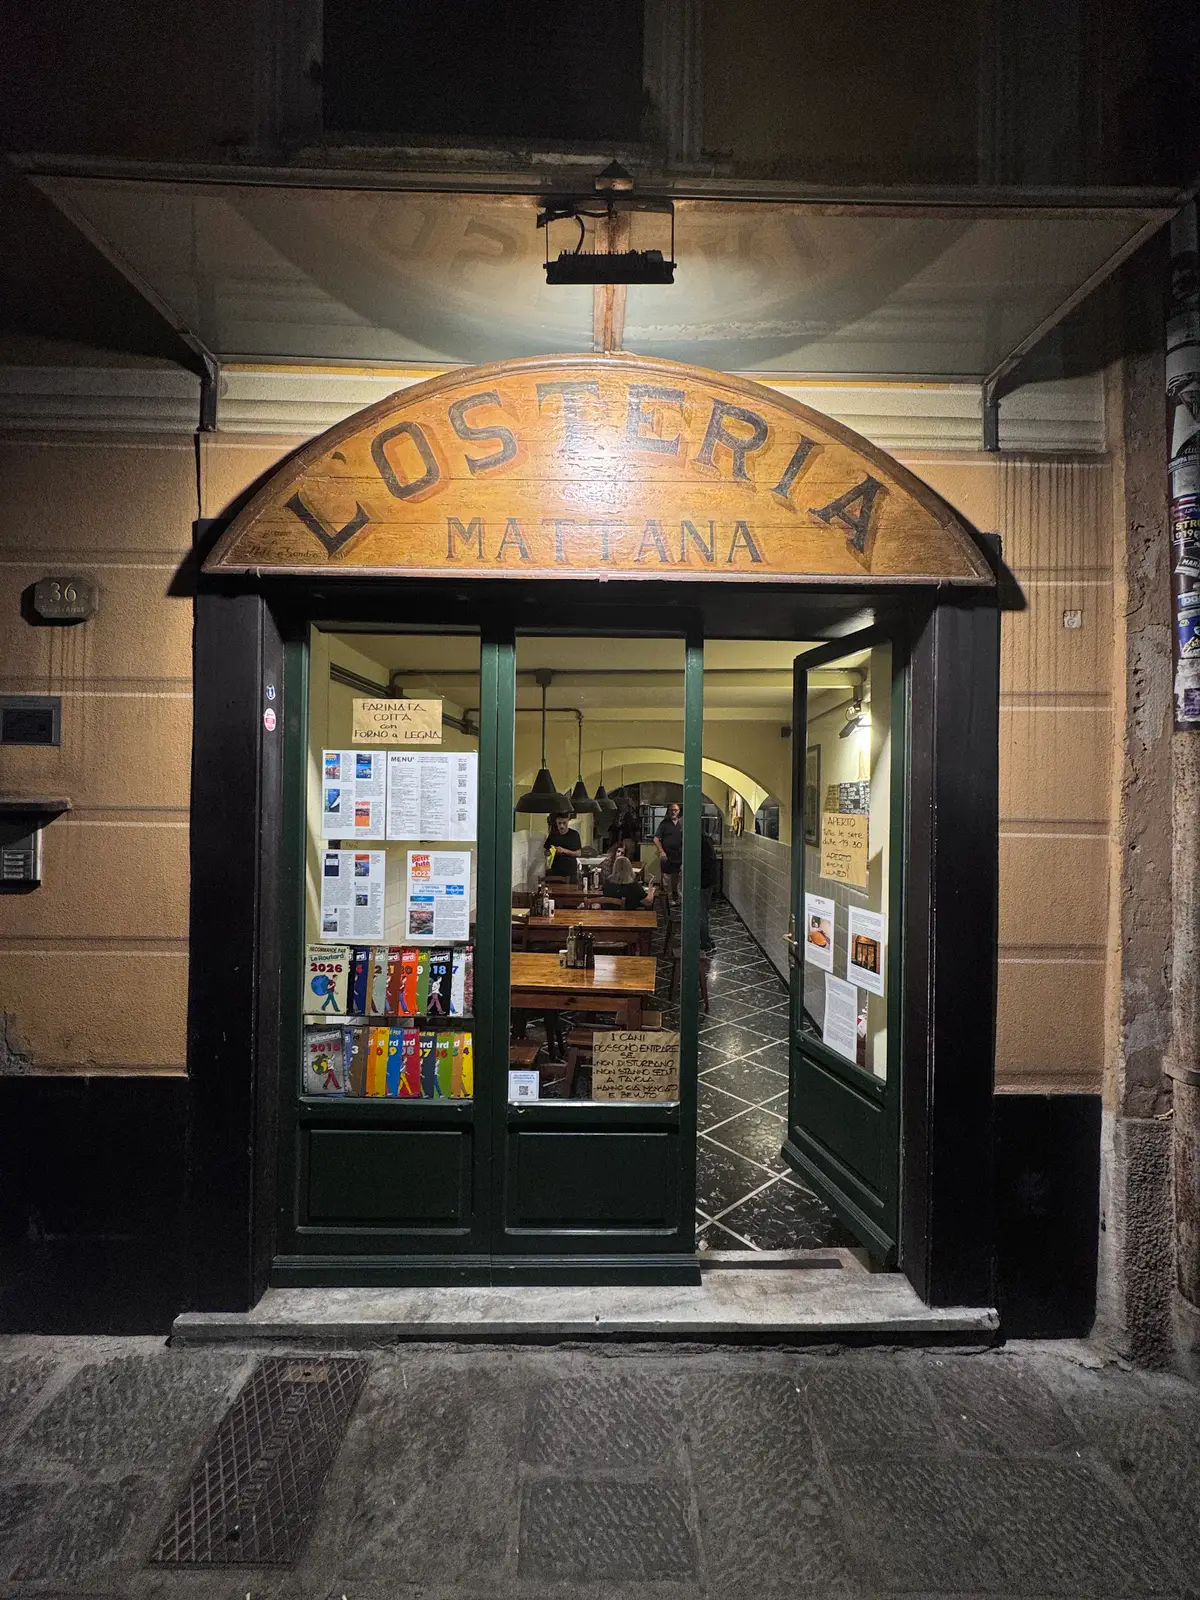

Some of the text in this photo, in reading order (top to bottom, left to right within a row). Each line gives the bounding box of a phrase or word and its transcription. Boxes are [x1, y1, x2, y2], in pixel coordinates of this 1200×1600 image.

[447, 516, 763, 564] MATTANA
[49, 582, 77, 603] 36
[362, 702, 427, 712] FARINATA
[373, 713, 412, 721] COTTA
[354, 730, 389, 739] FORNO
[404, 731, 443, 739] LEGNA
[827, 816, 856, 827] APERTO
[310, 963, 343, 973] 2026
[619, 1032, 645, 1041] CANI
[594, 1043, 680, 1053] POSSONO ENTRARE
[618, 1075, 655, 1083] TAVOLA
[620, 1091, 657, 1099] BEVUTO
